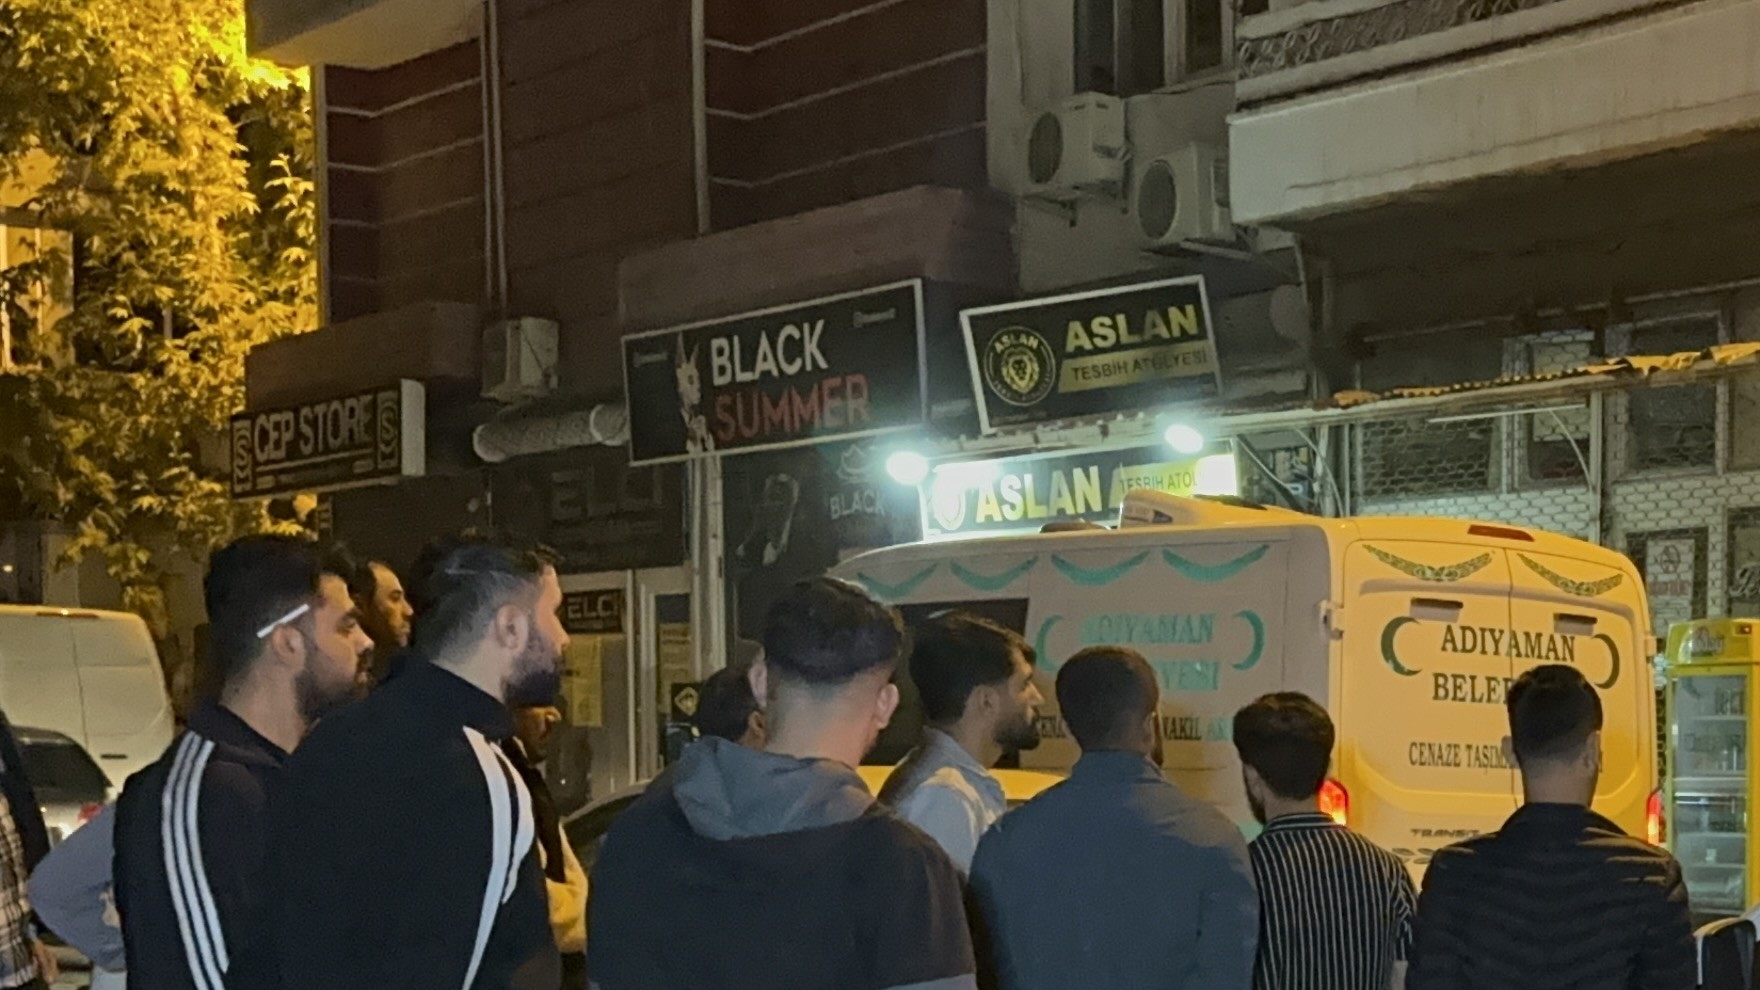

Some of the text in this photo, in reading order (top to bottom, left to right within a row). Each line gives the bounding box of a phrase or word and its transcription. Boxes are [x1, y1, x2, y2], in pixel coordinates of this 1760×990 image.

[711, 319, 829, 386] BLACK
[994, 333, 1039, 354] ASLAN
[1065, 304, 1199, 353] ASLAN
[255, 395, 374, 463] CEP STORE
[716, 374, 870, 441] SUMMER
[830, 490, 885, 520] BLACK
[976, 466, 1102, 523] ASLAN
[1441, 624, 1576, 663] ADIYAMAN
[1409, 741, 1462, 767] CENAZE
